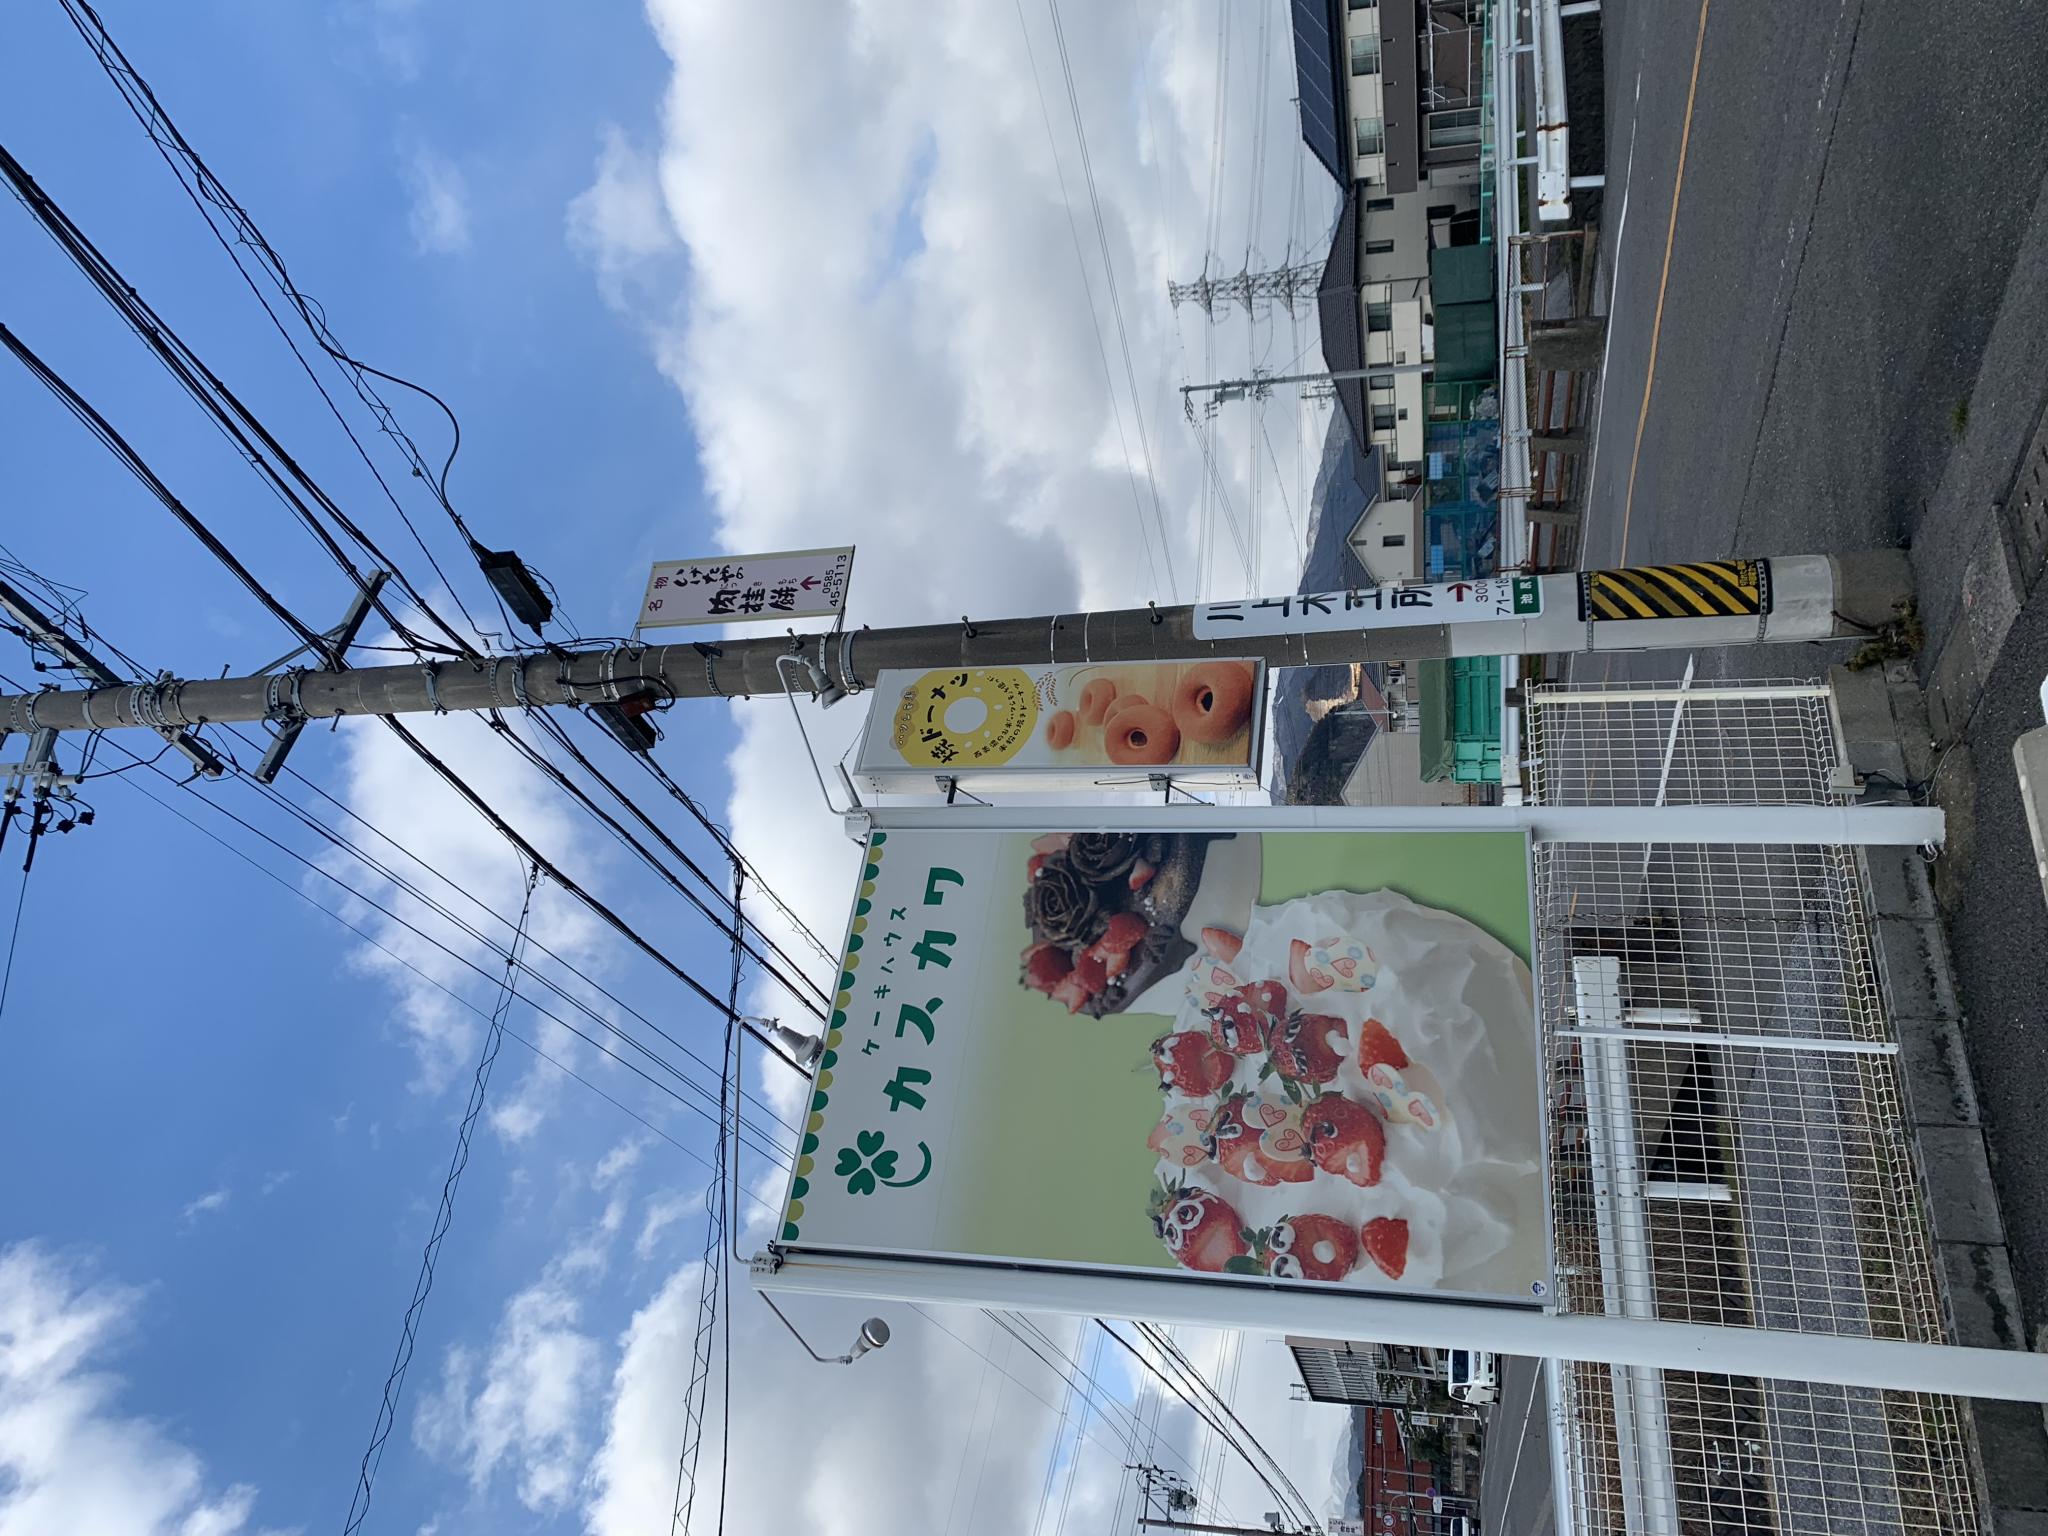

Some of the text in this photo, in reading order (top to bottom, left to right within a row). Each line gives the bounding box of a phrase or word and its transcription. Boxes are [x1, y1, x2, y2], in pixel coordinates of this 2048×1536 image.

[648, 576, 669, 611] 名物
[673, 565, 744, 587] いげたやの
[821, 569, 834, 594] 0585
[828, 554, 847, 607] 45-5113
[707, 586, 799, 615] 肉桂餅
[919, 672, 968, 764] 焼ドーナツ
[861, 906, 907, 1056] ケーキハウス
[882, 866, 964, 1113] カスカワ
